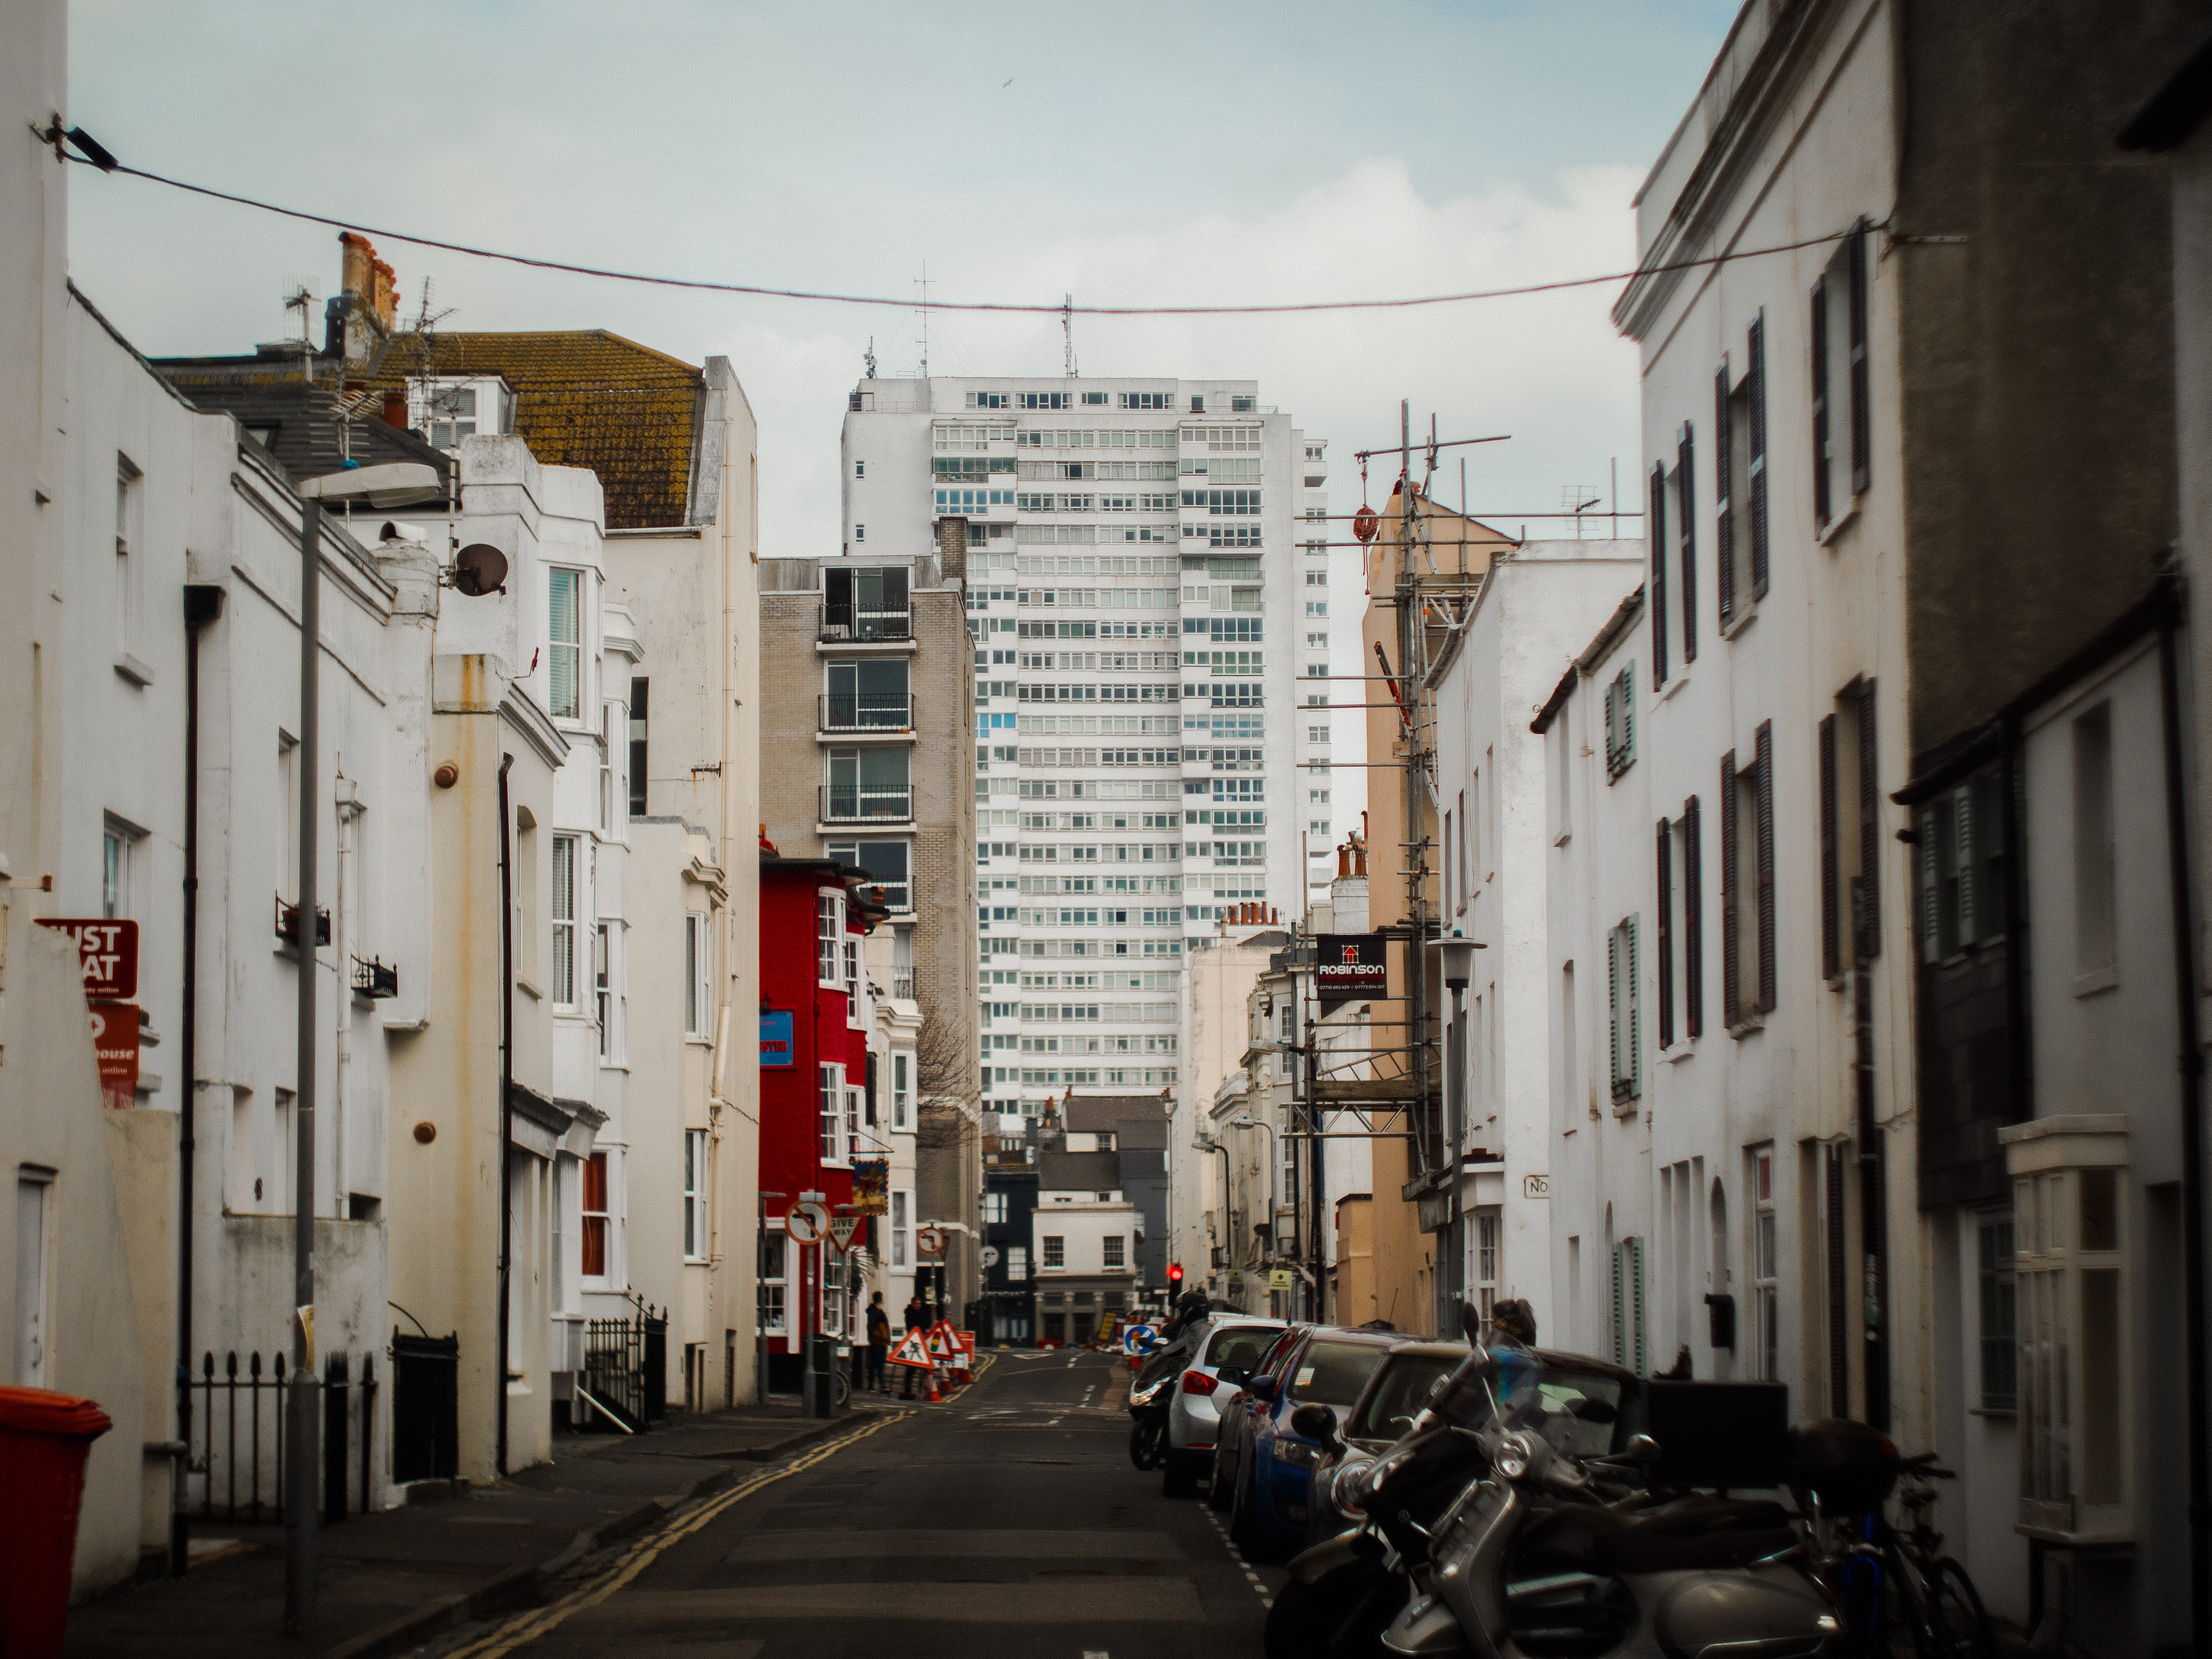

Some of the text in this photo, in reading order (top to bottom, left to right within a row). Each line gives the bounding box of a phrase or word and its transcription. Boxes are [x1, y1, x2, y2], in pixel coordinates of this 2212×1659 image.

[51, 925, 121, 952] UST
[1319, 965, 1384, 975] ROBINSON
[1530, 1181, 1548, 1192] NO
